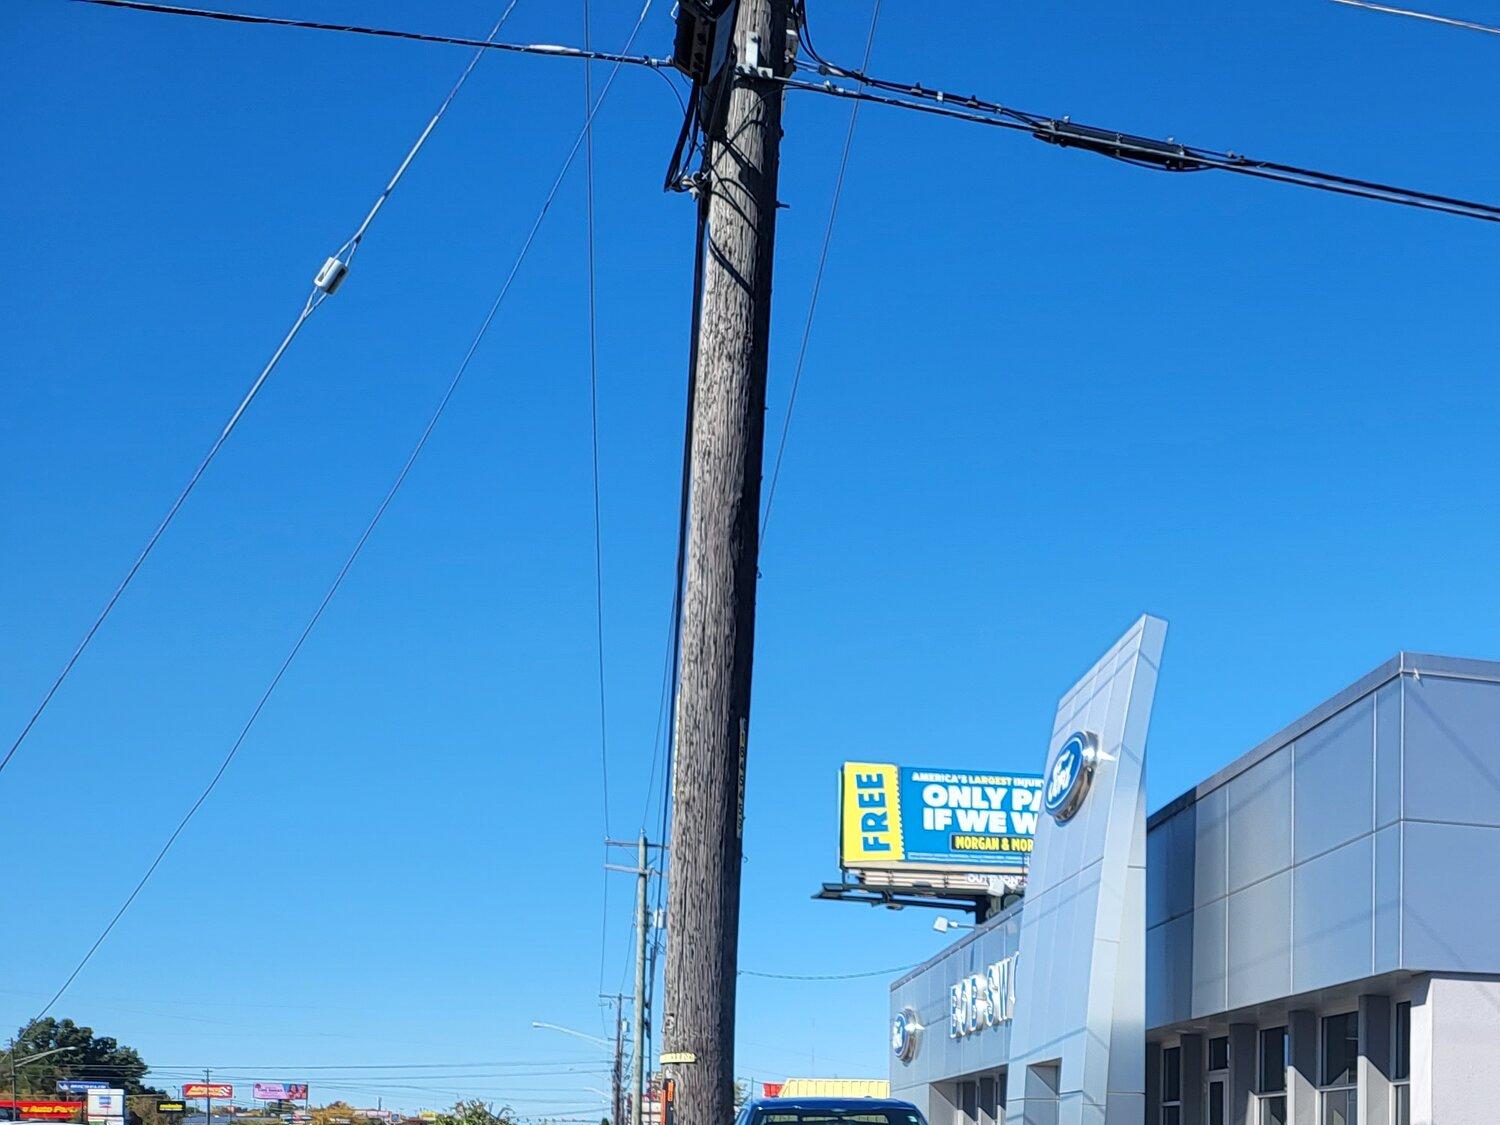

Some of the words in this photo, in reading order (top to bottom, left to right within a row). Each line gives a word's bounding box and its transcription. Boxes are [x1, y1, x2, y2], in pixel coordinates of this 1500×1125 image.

[912, 772, 967, 784] AMERICA'S
[969, 775, 1012, 787] LARGEST
[922, 784, 1008, 809] ONLY
[855, 773, 891, 852] FREE
[923, 807, 952, 831] IF
[955, 808, 1008, 833] WE
[955, 835, 1000, 850] MORGAN
[1000, 837, 1010, 851] &
